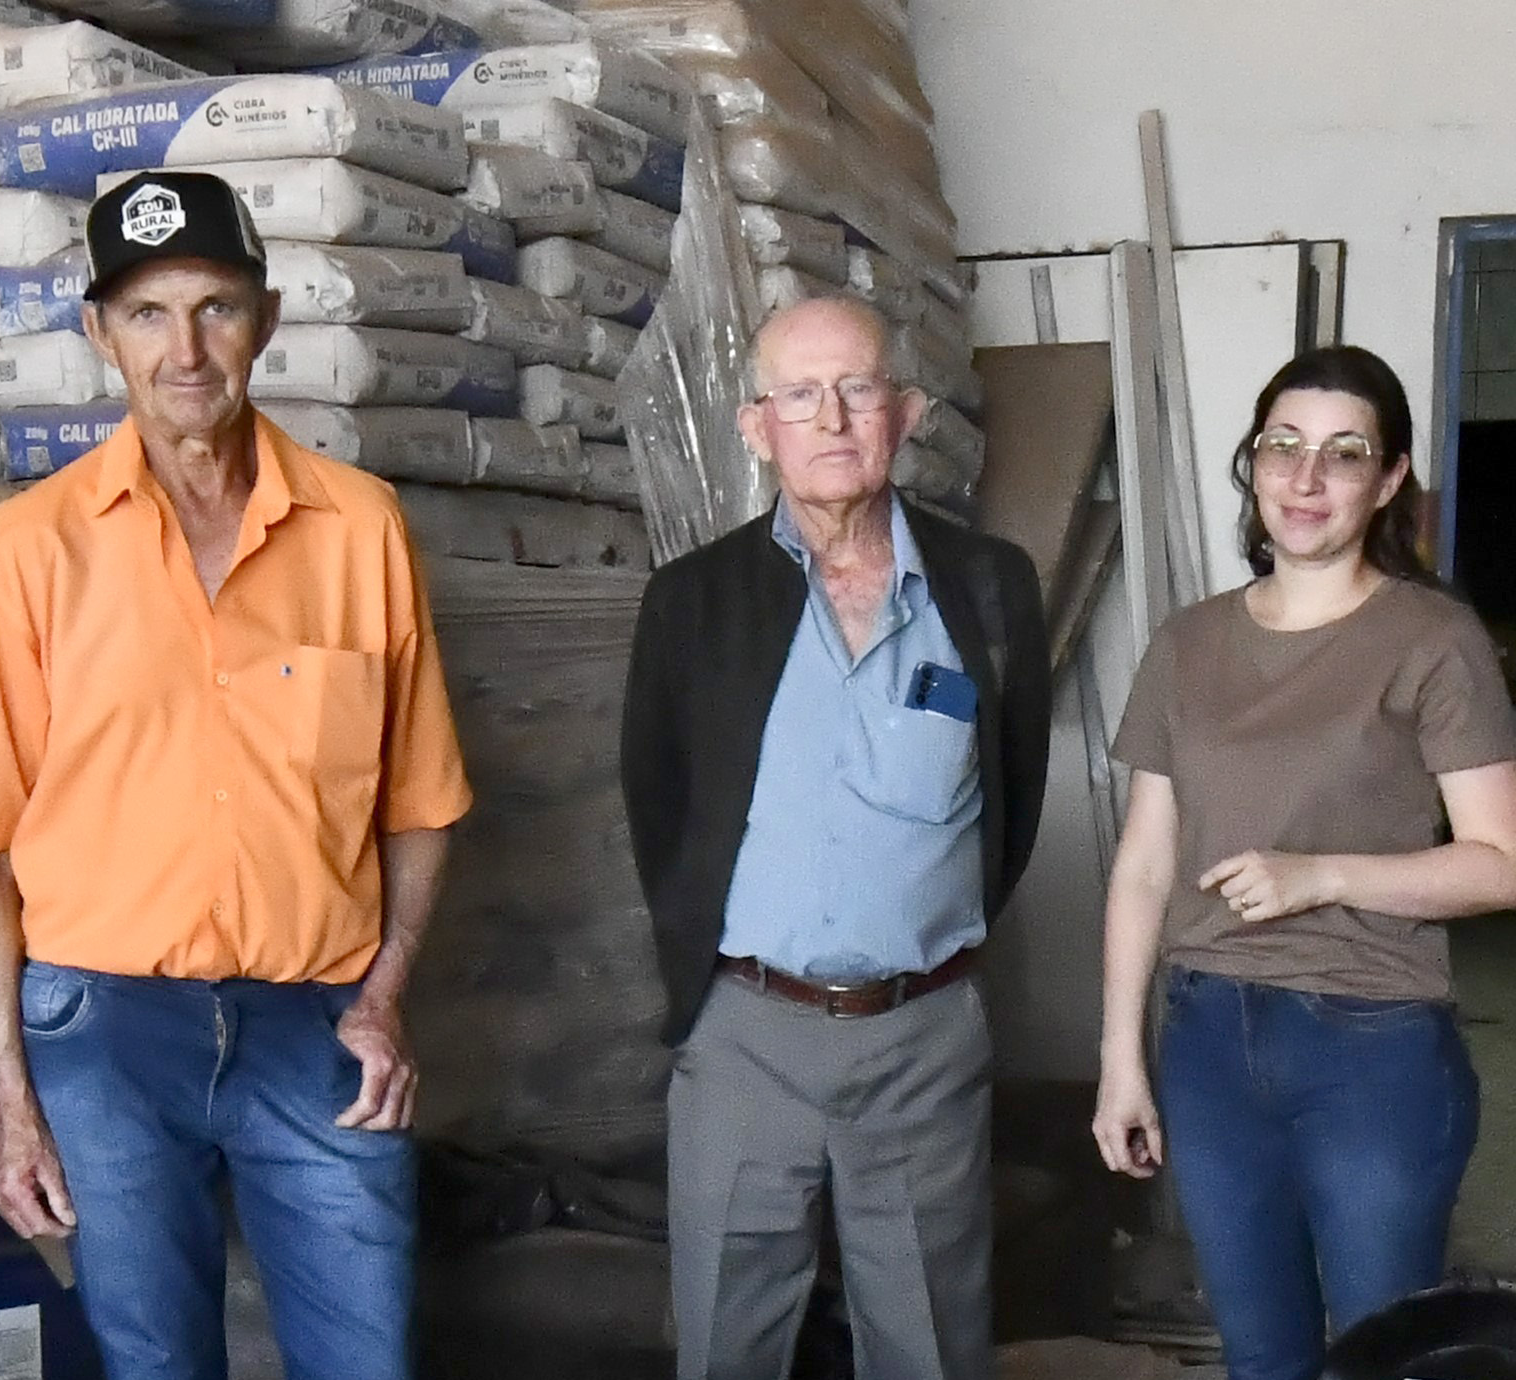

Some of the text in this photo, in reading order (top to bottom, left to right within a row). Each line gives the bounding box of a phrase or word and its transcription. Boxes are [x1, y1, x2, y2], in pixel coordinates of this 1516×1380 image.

[337, 62, 449, 86] CAL HIDRATADA
[234, 99, 266, 110] CIBRA
[51, 117, 81, 137] CAL
[85, 101, 179, 131] HIDRATADA
[235, 110, 287, 124] MINÉRIOS
[92, 126, 138, 151] CH-III
[137, 202, 163, 216] SOU
[130, 215, 175, 232] RURAL
[53, 276, 83, 296] CAL
[59, 424, 90, 443] CAL
